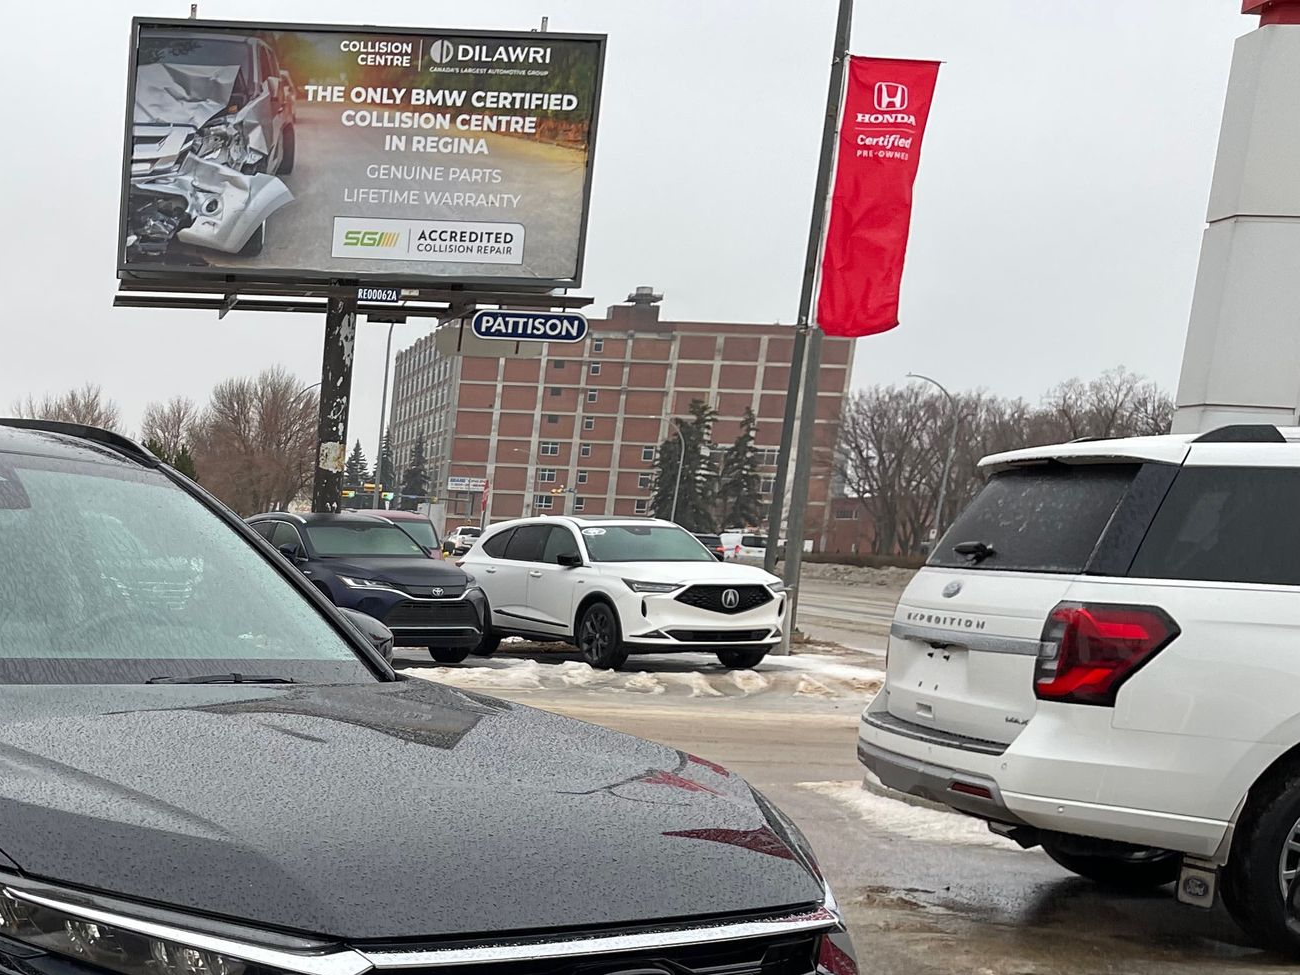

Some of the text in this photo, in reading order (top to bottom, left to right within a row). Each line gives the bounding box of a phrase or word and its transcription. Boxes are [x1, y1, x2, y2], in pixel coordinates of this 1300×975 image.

[340, 41, 412, 54] COLLISION
[457, 45, 551, 64] DILAWRI
[358, 55, 411, 67] CENTRE
[304, 85, 578, 111] THE ONLY BMW CERTIFIED
[341, 110, 537, 134] COLLISION CENTRE
[856, 113, 916, 126] HONDA
[385, 135, 489, 155] IN REGINA
[857, 134, 912, 149] Certified
[366, 164, 502, 183] GENUINE PARTS
[344, 188, 521, 208] LIFETIME WARRANTY
[343, 230, 385, 247] SGI
[417, 230, 514, 244] ACCREDITED
[416, 243, 512, 255] COLLISION REPAIR
[357, 288, 397, 301] RE00062A
[481, 316, 579, 336] PATTISON
[907, 612, 985, 629] EXPEDITION
